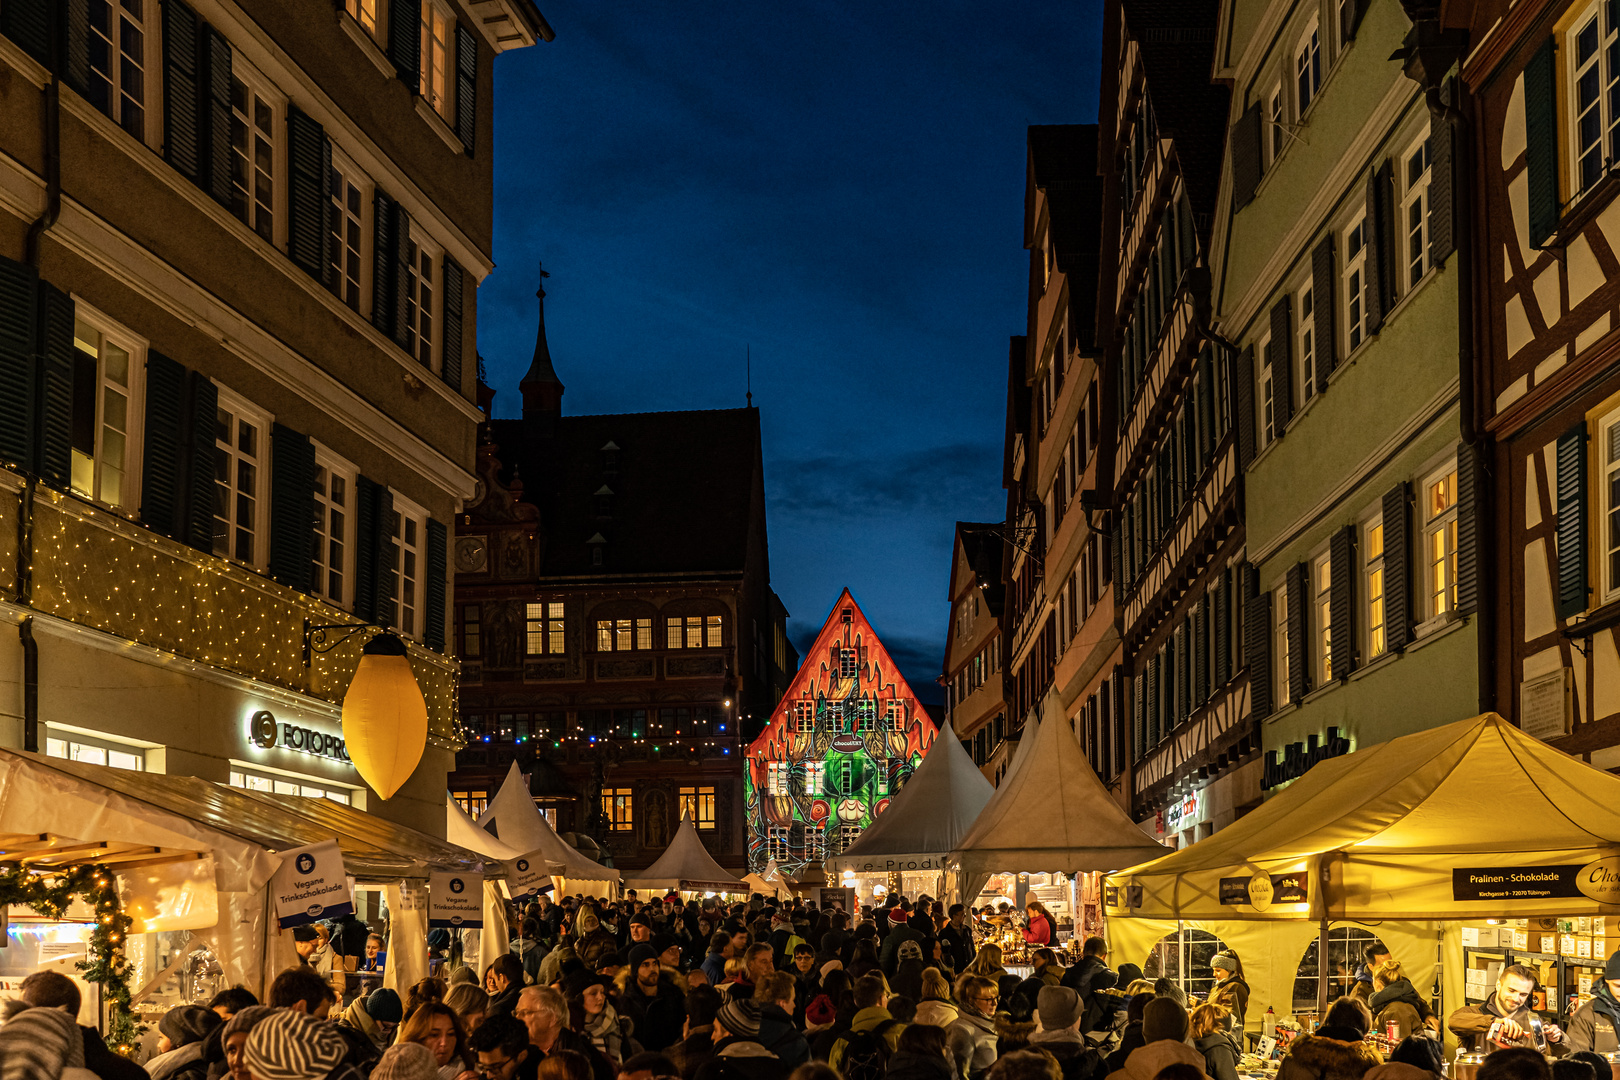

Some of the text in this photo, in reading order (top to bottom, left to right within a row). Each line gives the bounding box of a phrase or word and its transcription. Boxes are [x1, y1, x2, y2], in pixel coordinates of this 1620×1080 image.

[517, 872, 536, 881] Vegane
[1470, 874, 1504, 883] Pralinen
[1510, 872, 1560, 882] Schokolade
[294, 877, 325, 889] Vegane
[280, 883, 343, 904] Trinkschokolade
[1527, 889, 1551, 897] Tübingen
[446, 896, 468, 904] Vegane
[433, 903, 480, 911] Trinkschokolade
